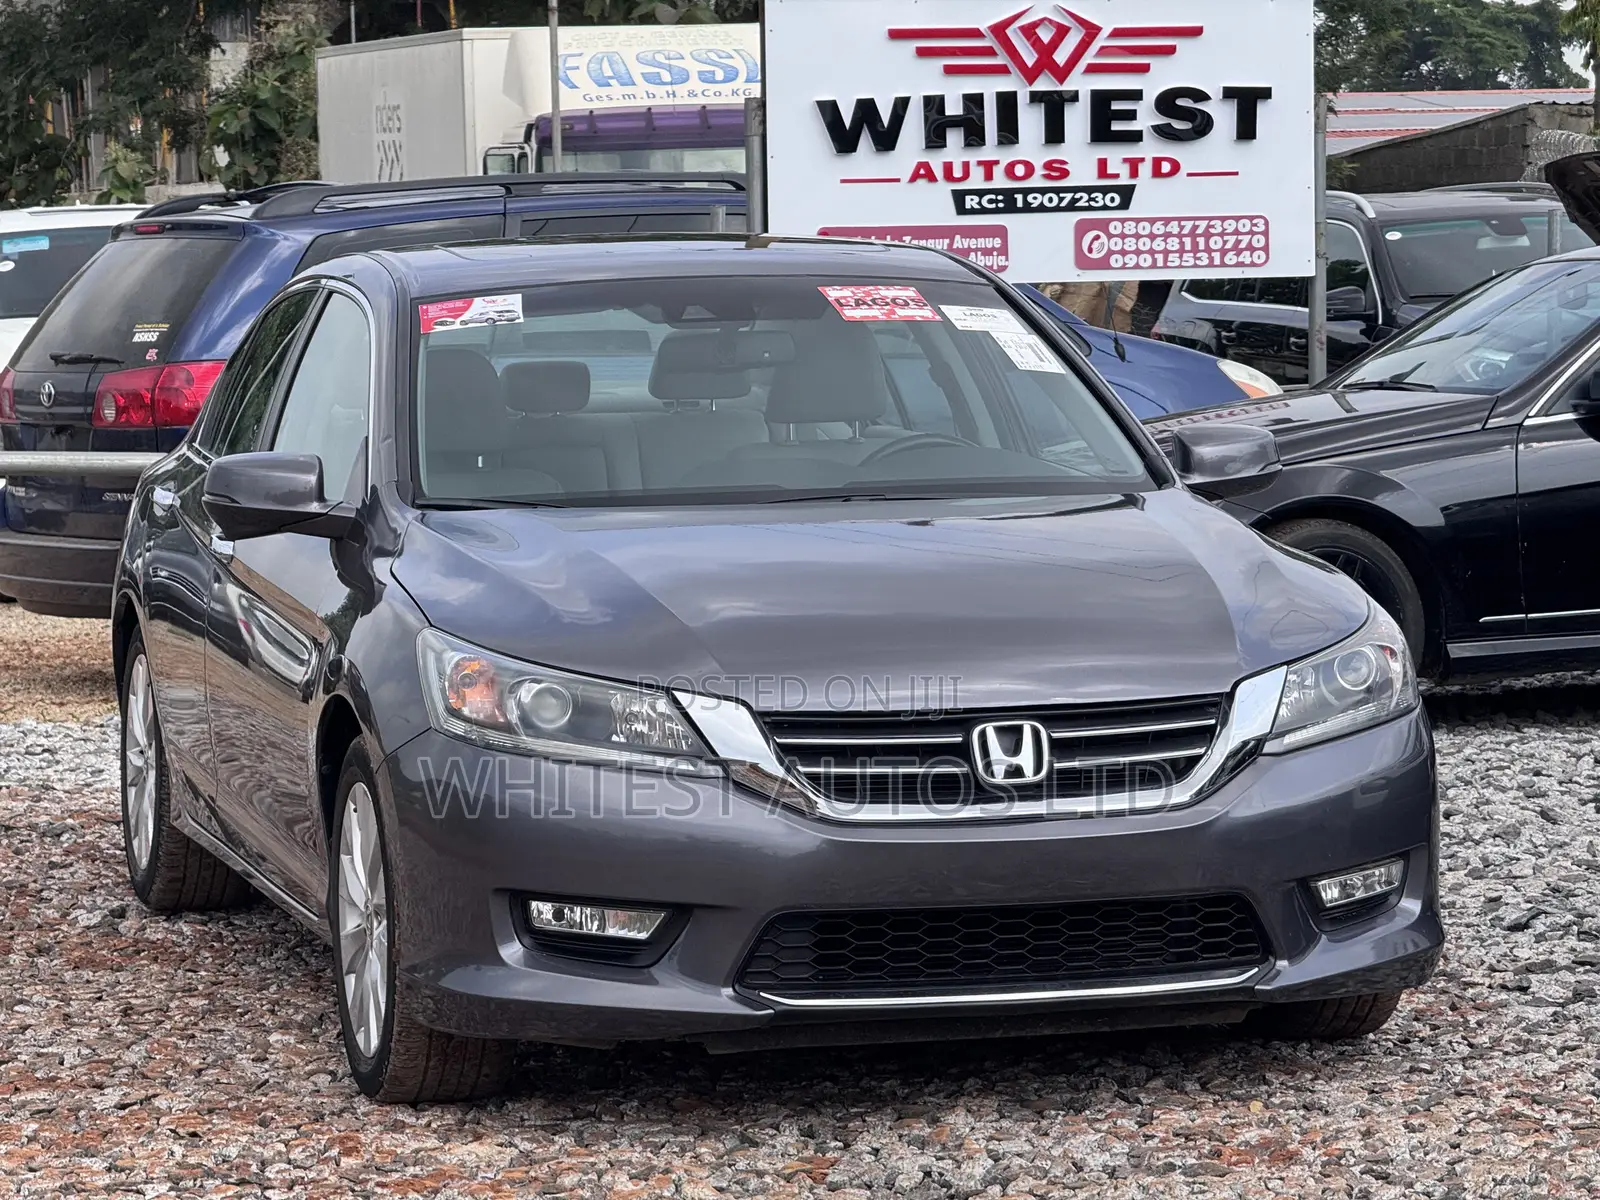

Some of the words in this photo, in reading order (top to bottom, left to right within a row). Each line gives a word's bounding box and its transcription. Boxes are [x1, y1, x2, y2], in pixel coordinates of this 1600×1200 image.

[817, 86, 1273, 154] WHITEST
[908, 158, 1070, 183] AUTOS
[1096, 156, 1182, 180] LTD
[964, 194, 1004, 209] RC:
[1013, 192, 1121, 209] 1907230
[1108, 218, 1266, 235] 08064773903
[952, 235, 1002, 249] Avenue
[1108, 234, 1266, 251] 08068110770
[1109, 250, 1267, 268] 09015531640
[833, 298, 929, 308] LAGOS
